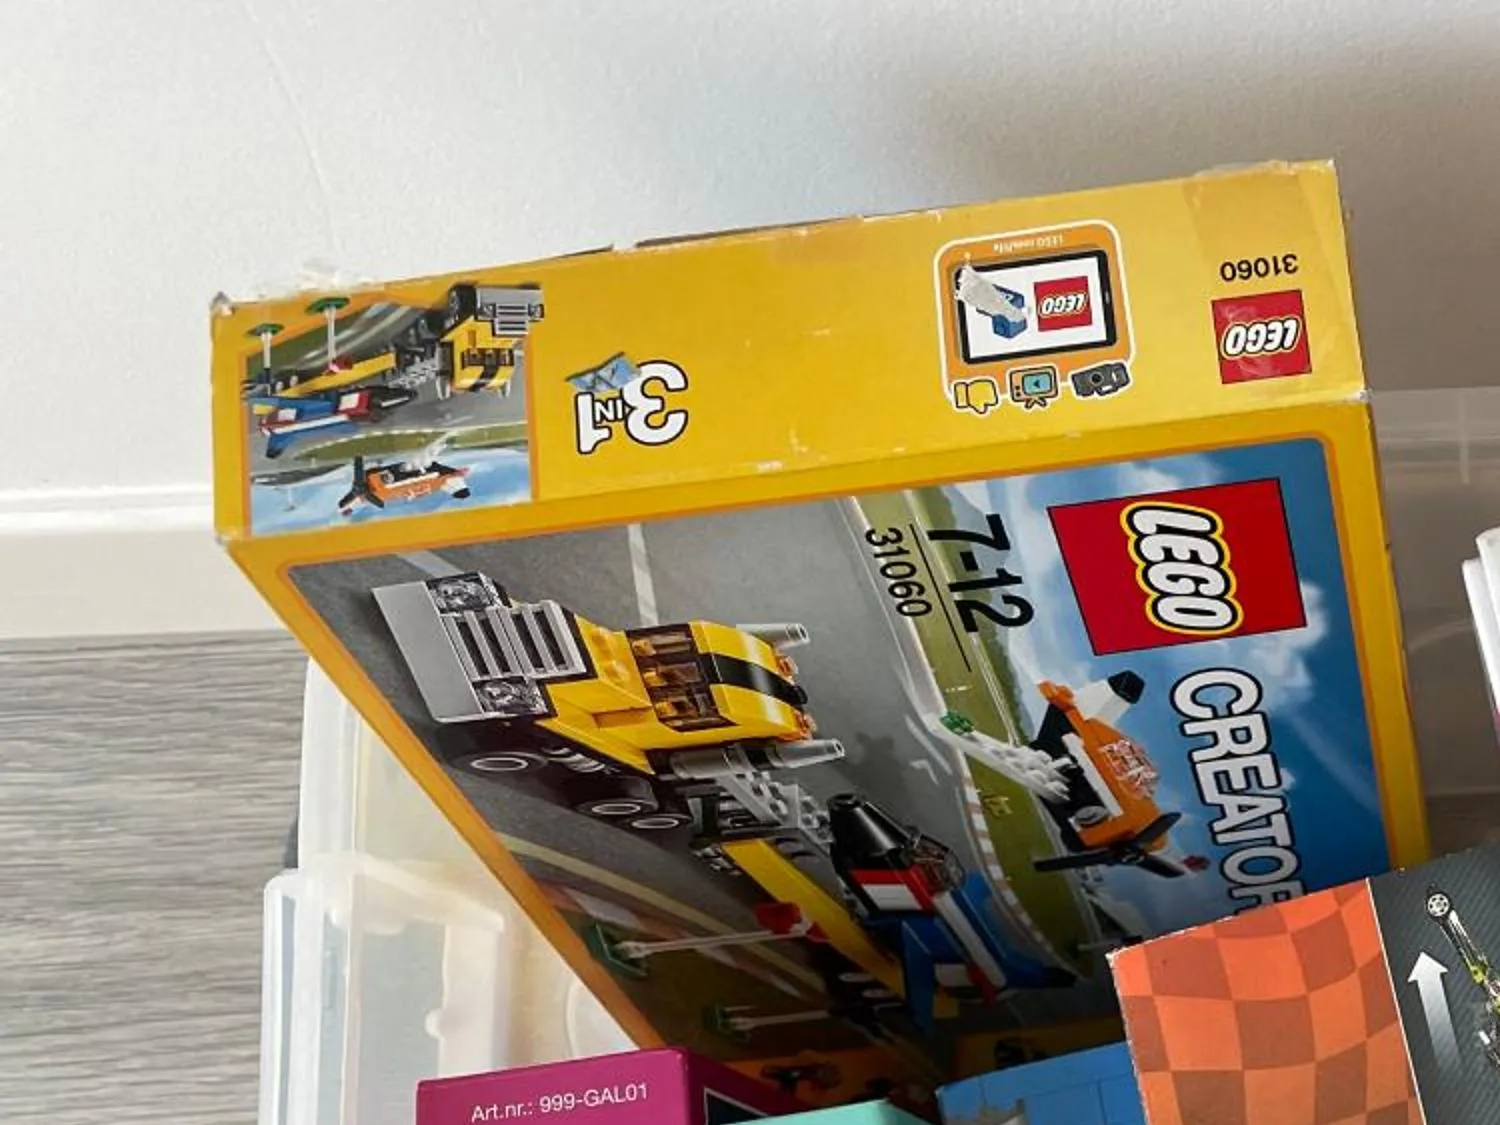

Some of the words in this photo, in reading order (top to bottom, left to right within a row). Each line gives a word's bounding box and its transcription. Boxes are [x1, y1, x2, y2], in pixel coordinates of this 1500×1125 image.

[1219, 254, 1300, 283] 31060
[1040, 292, 1086, 317] LEGO
[1222, 317, 1300, 356] LEGO
[865, 526, 932, 617] 31060
[927, 513, 1034, 633] 7-12
[1123, 504, 1240, 632] LEGO
[539, 1083, 649, 1114] 999-GAL01
